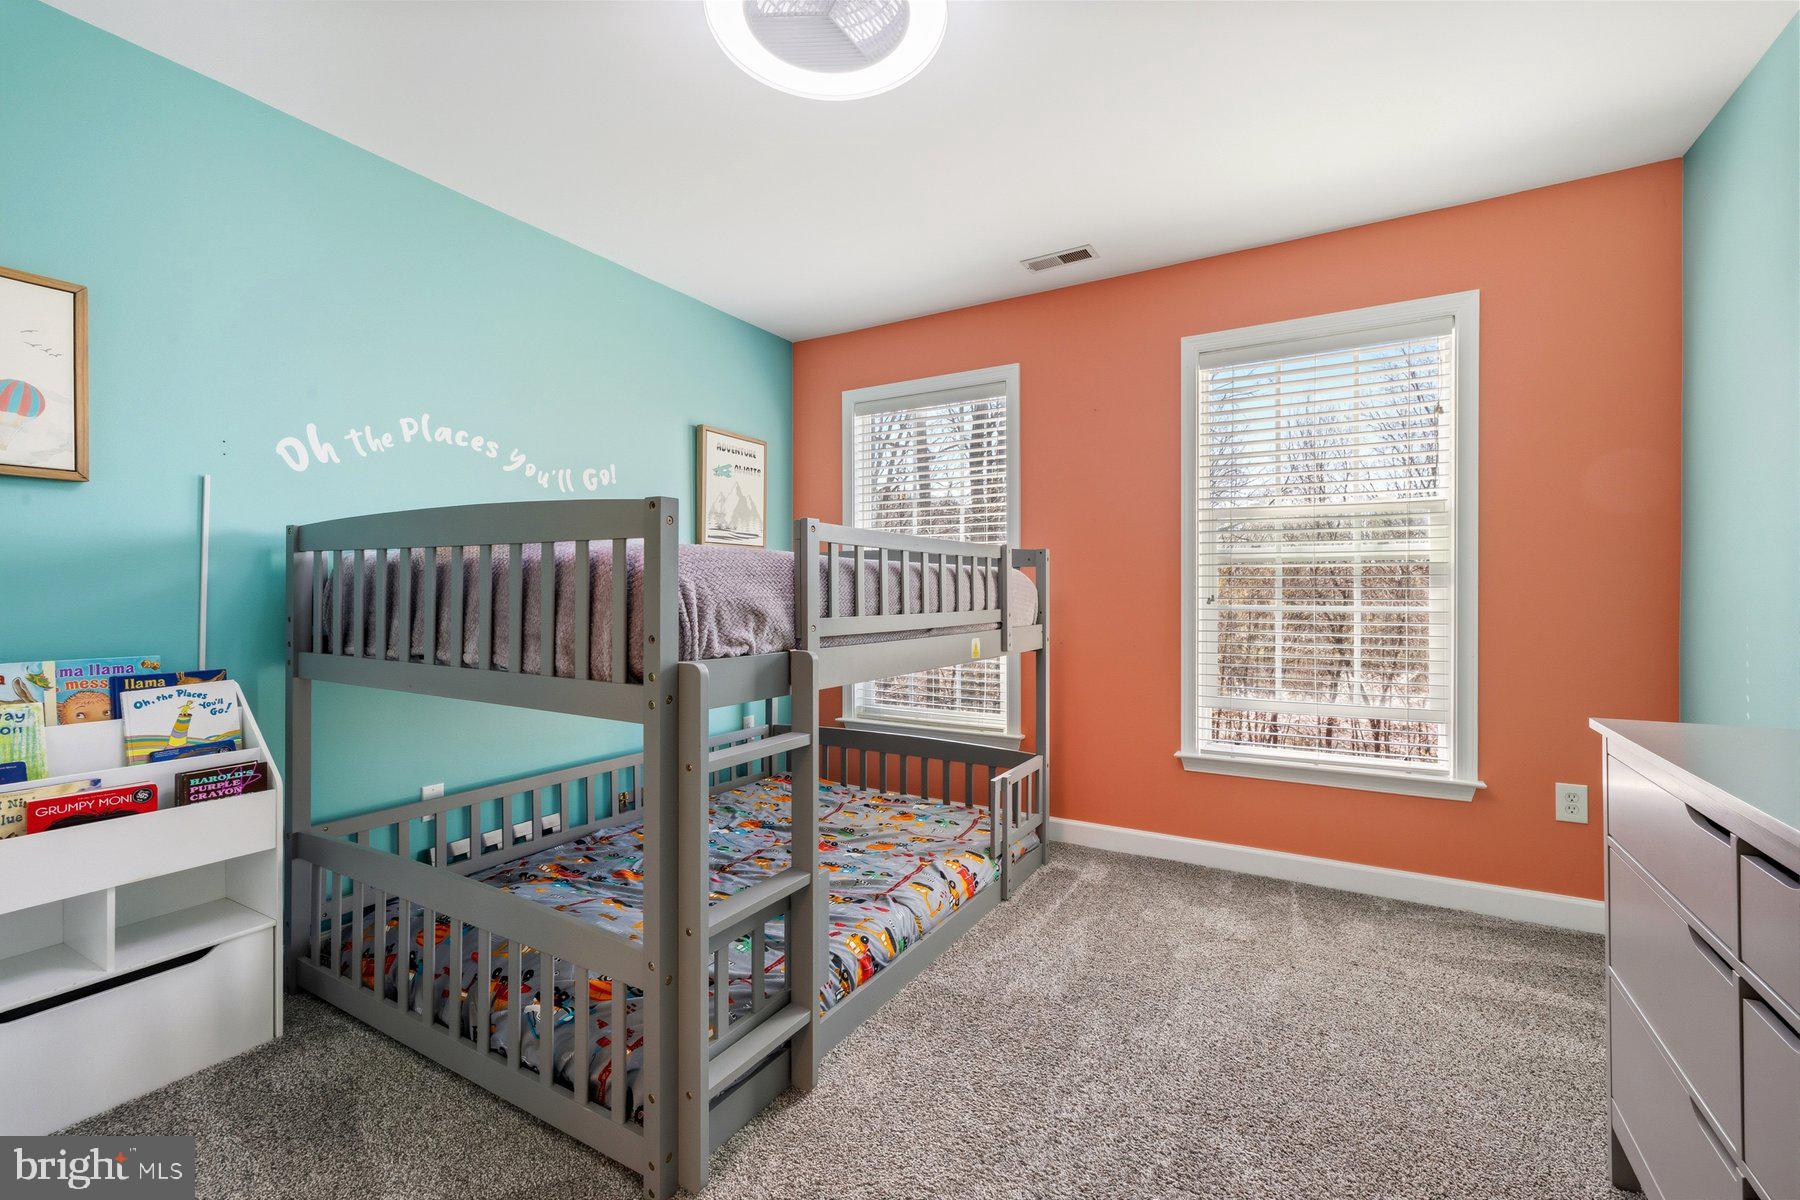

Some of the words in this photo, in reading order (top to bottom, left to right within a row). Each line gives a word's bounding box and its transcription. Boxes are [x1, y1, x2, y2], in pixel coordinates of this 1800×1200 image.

[275, 423, 341, 472] Oh
[344, 426, 394, 457] the
[399, 413, 499, 458] Places
[582, 464, 616, 491] Go!
[88, 663, 134, 676] llama
[124, 678, 166, 689] llama
[156, 693, 174, 702] the
[175, 689, 208, 700] Places
[198, 698, 224, 709] You'll
[210, 702, 232, 716] Go!
[190, 769, 254, 786] HAROLD'S
[190, 779, 241, 794] PURPLE
[190, 786, 243, 802] CRAYON
[35, 800, 94, 817] GRUMPY
